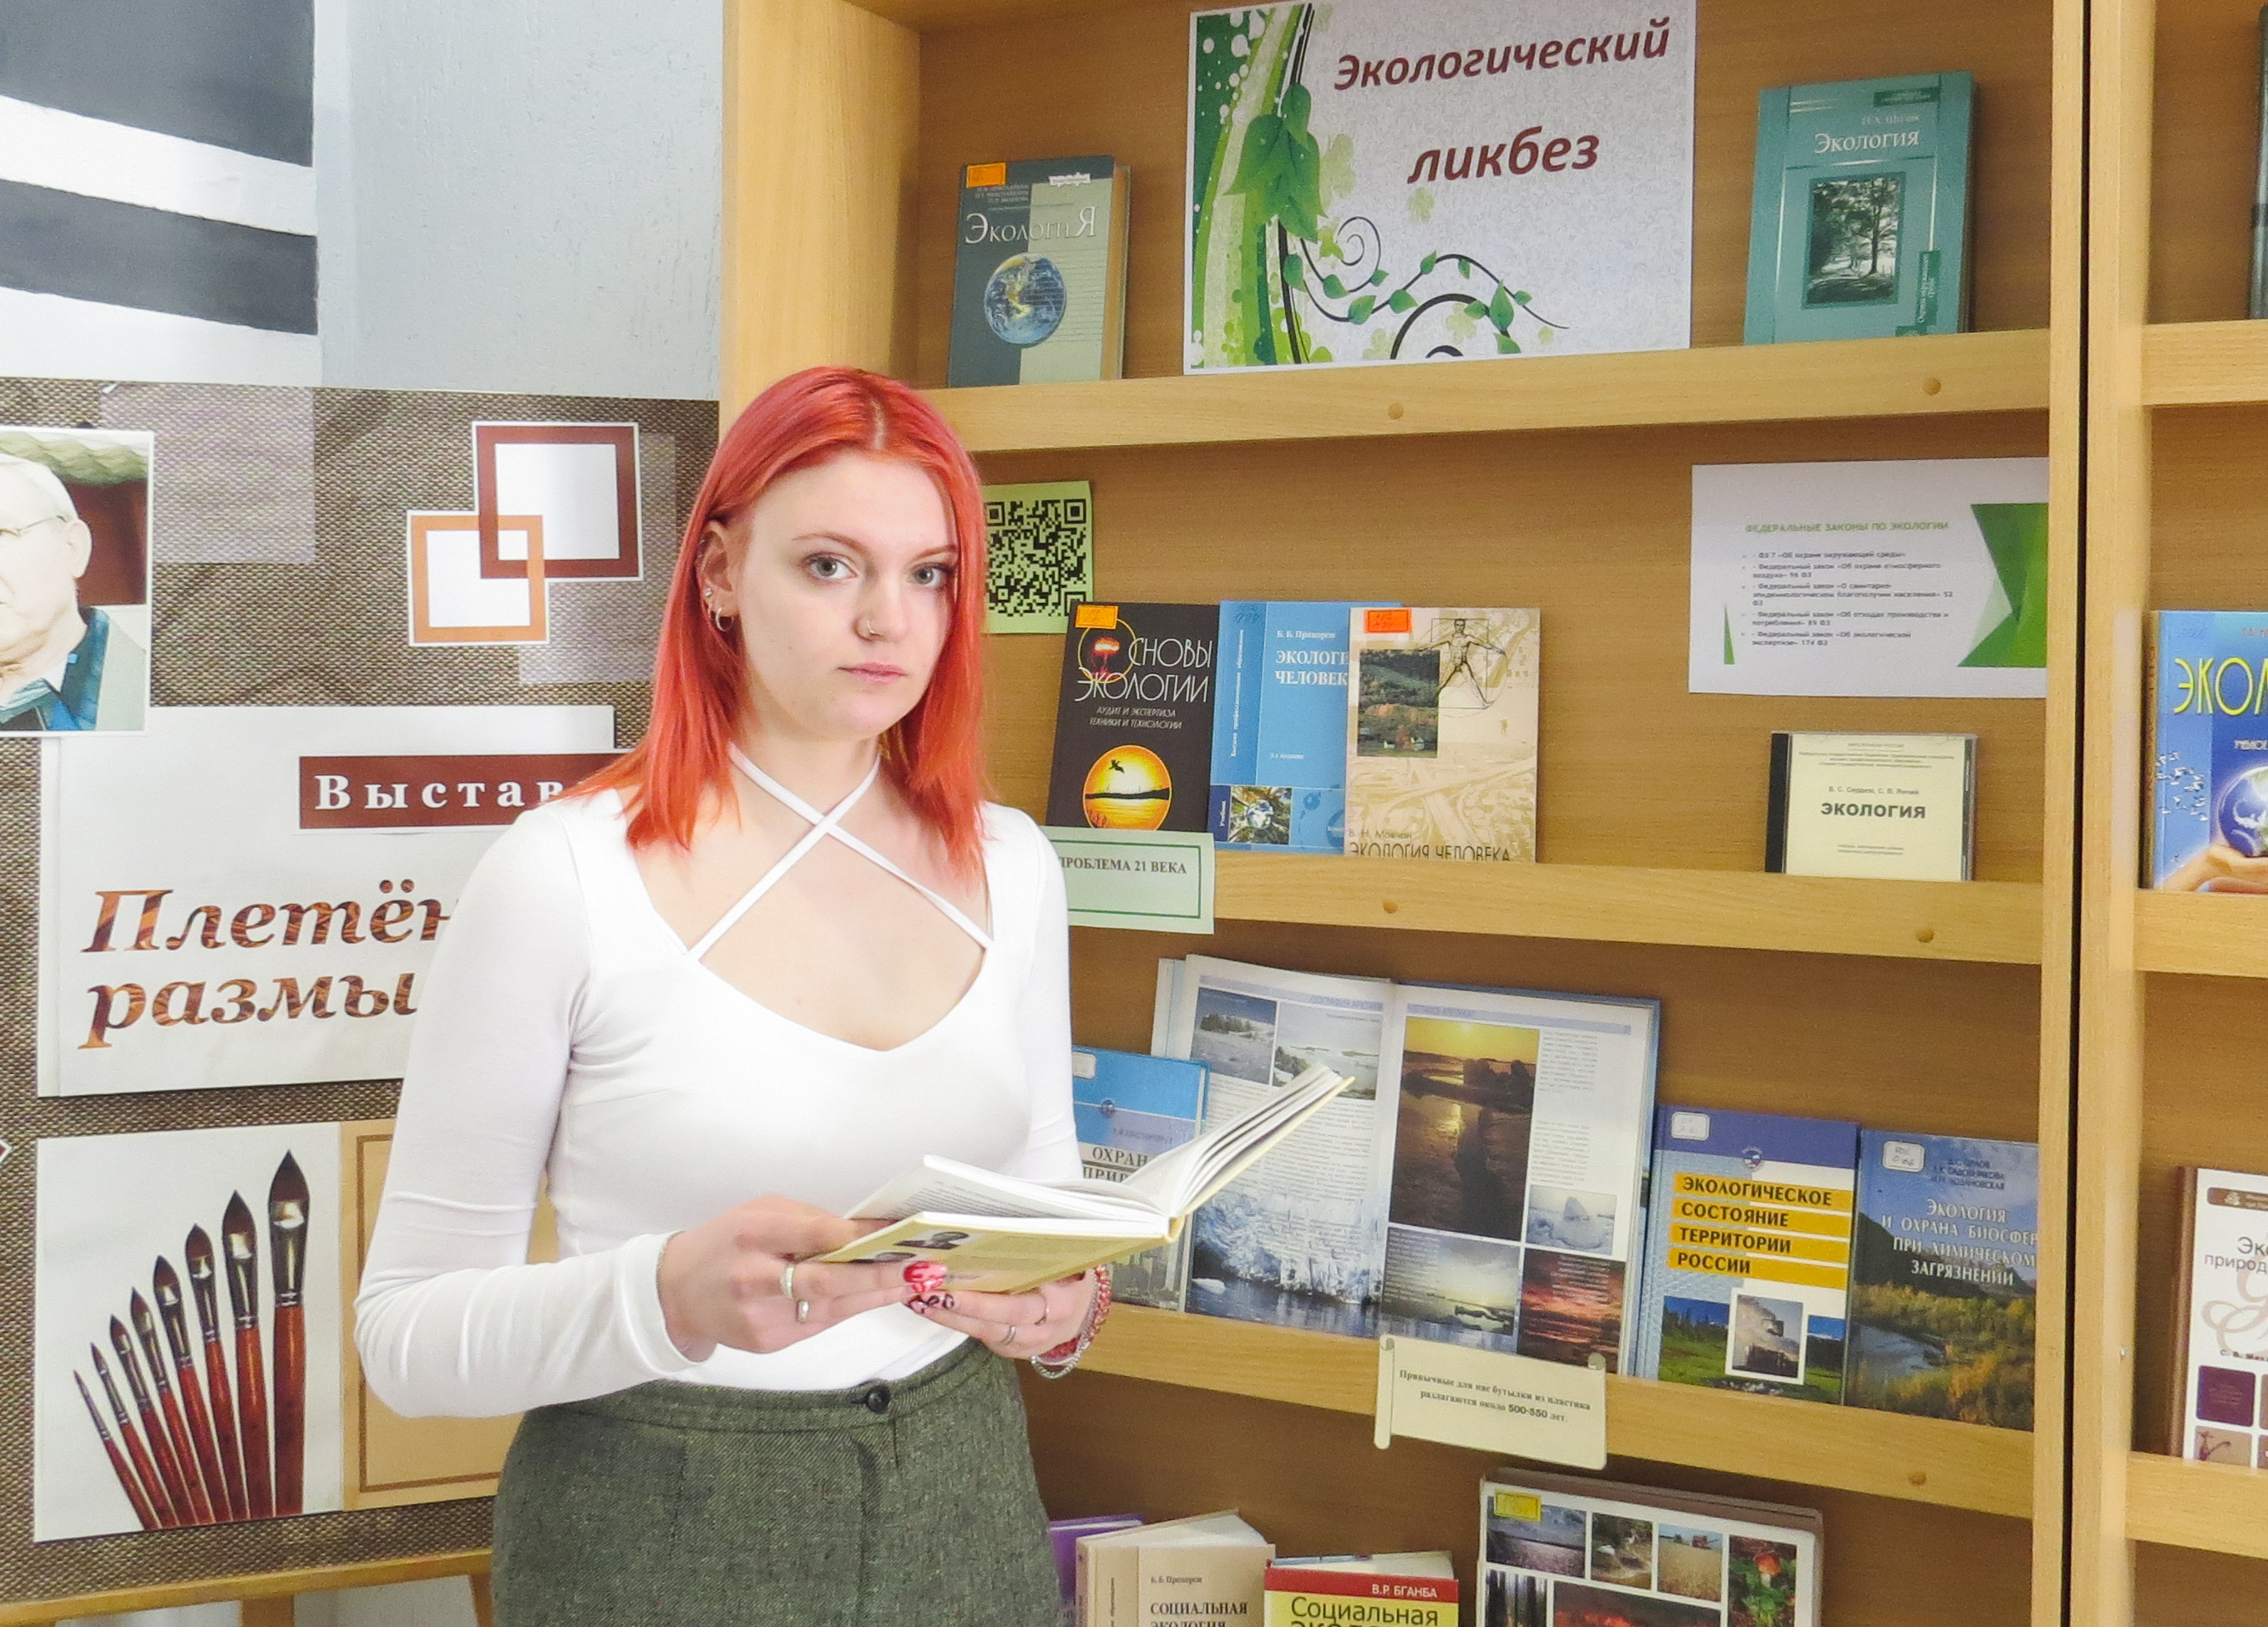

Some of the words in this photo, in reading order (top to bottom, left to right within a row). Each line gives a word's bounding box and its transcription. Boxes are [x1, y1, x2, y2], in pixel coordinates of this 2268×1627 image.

[1334, 17, 1669, 91] Экологический
[1406, 125, 1600, 185] ликбез
[1813, 130, 1921, 154] Экология
[1745, 523, 1821, 533] ФЕДЕРАЛЬНЫЕ
[1825, 521, 1869, 532] ЗАКОНЫ
[1872, 521, 1886, 531] ПО
[1889, 521, 1948, 531] ЭКОЛОГИИ
[1075, 667, 1209, 702] ЭКОЛОГИИ
[315, 773, 564, 810] Выстав
[1820, 802, 1926, 819] ЭКОЛОГИЯ
[1134, 860, 1147, 872] 21
[1151, 861, 1187, 874] ВЕКА
[80, 879, 455, 954] Плетён
[78, 972, 418, 1050] размы
[1092, 1146, 1148, 1167] ОХРАН
[1682, 1176, 1832, 1206] ЭКОЛОГИЧЕСКОЕ
[1681, 1202, 1789, 1227] СОСТОЯНИЕ
[1881, 1214, 1893, 1229] И
[1901, 1217, 1958, 1237] ОХРАНА
[1679, 1227, 1791, 1254] ТЕРРИТОРИИ
[1892, 1236, 1922, 1254] ПРИ
[1678, 1252, 1750, 1274] РОССИИ
[1911, 1260, 2014, 1286] ЗАГРЯЗНЕНИИ
[1400, 1369, 1455, 1386] Привычные
[1492, 1386, 1532, 1400] бутылки
[1420, 1391, 1477, 1406] разлагаются
[1508, 1404, 1547, 1418] 500-550
[1150, 1602, 1248, 1615] СОЦИАЛЬНАЯ
[1290, 1596, 1439, 1627] Социальная
